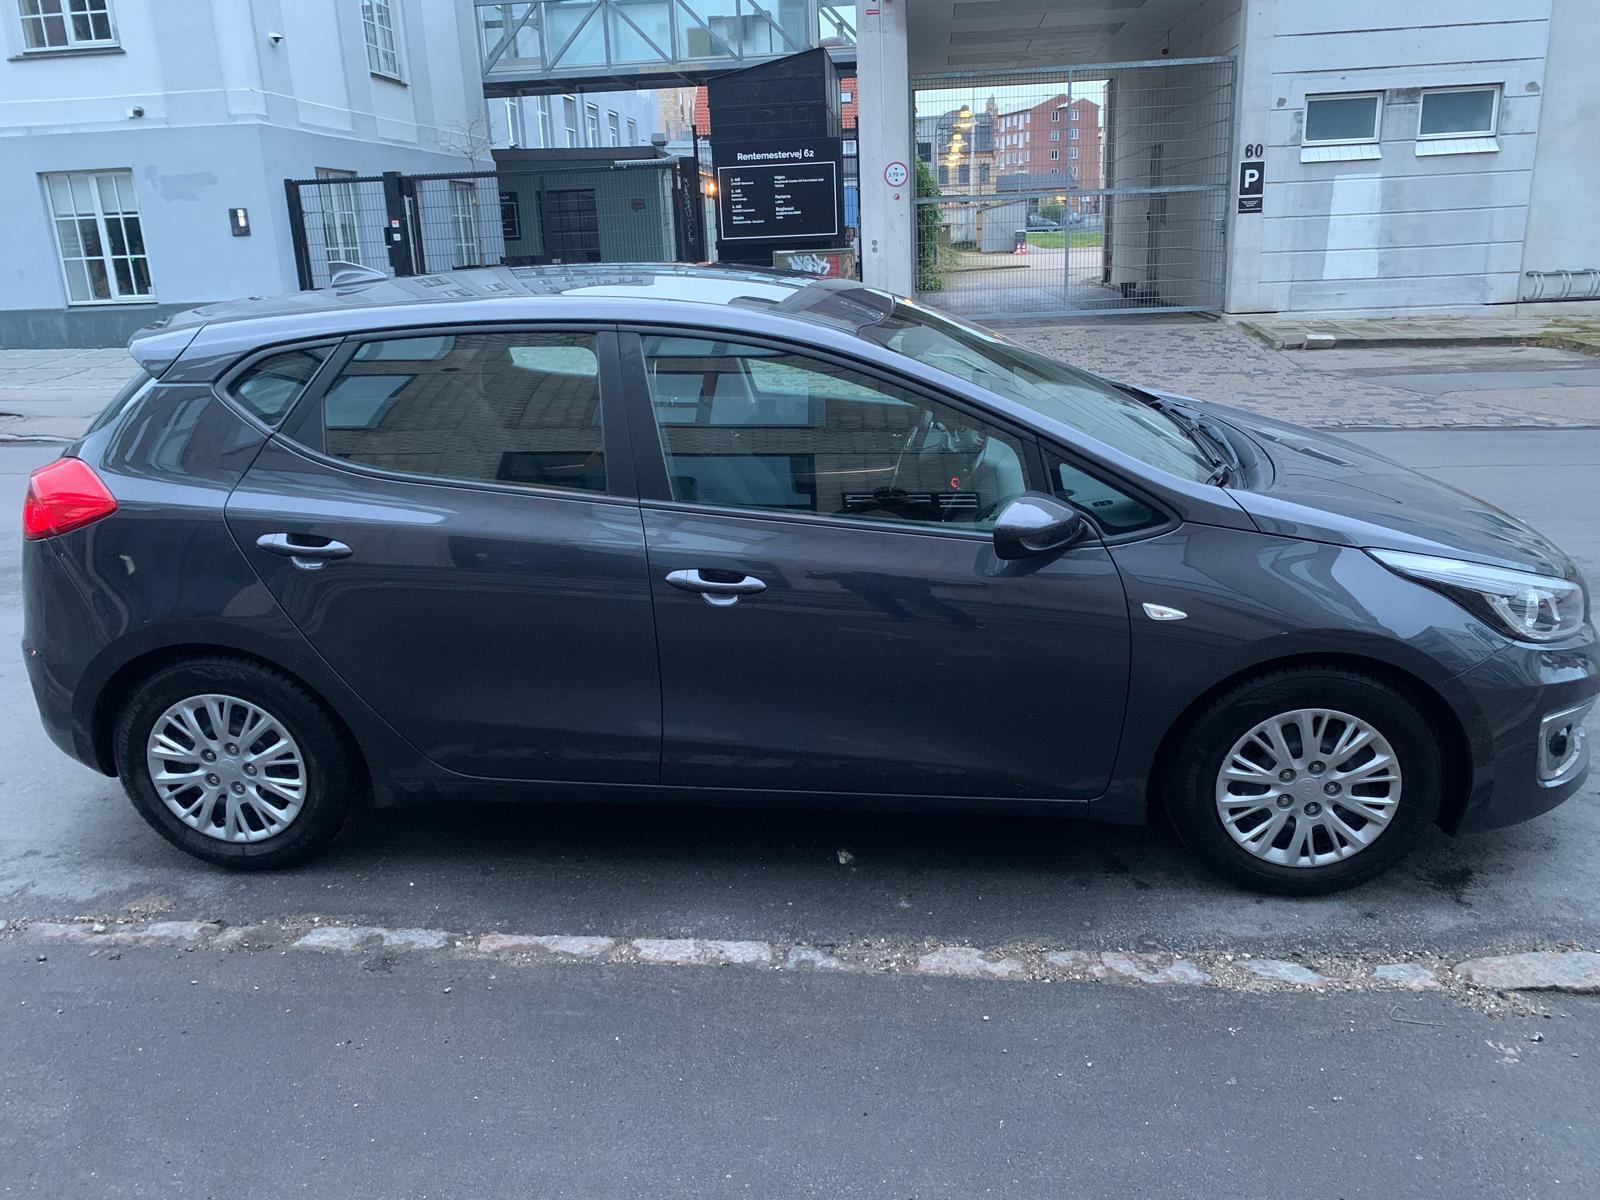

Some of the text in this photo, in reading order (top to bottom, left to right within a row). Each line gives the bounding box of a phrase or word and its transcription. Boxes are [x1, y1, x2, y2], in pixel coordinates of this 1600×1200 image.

[737, 149, 814, 160] Rentemestervej 62
[1245, 144, 1263, 158] 60
[1245, 169, 1259, 188] P
